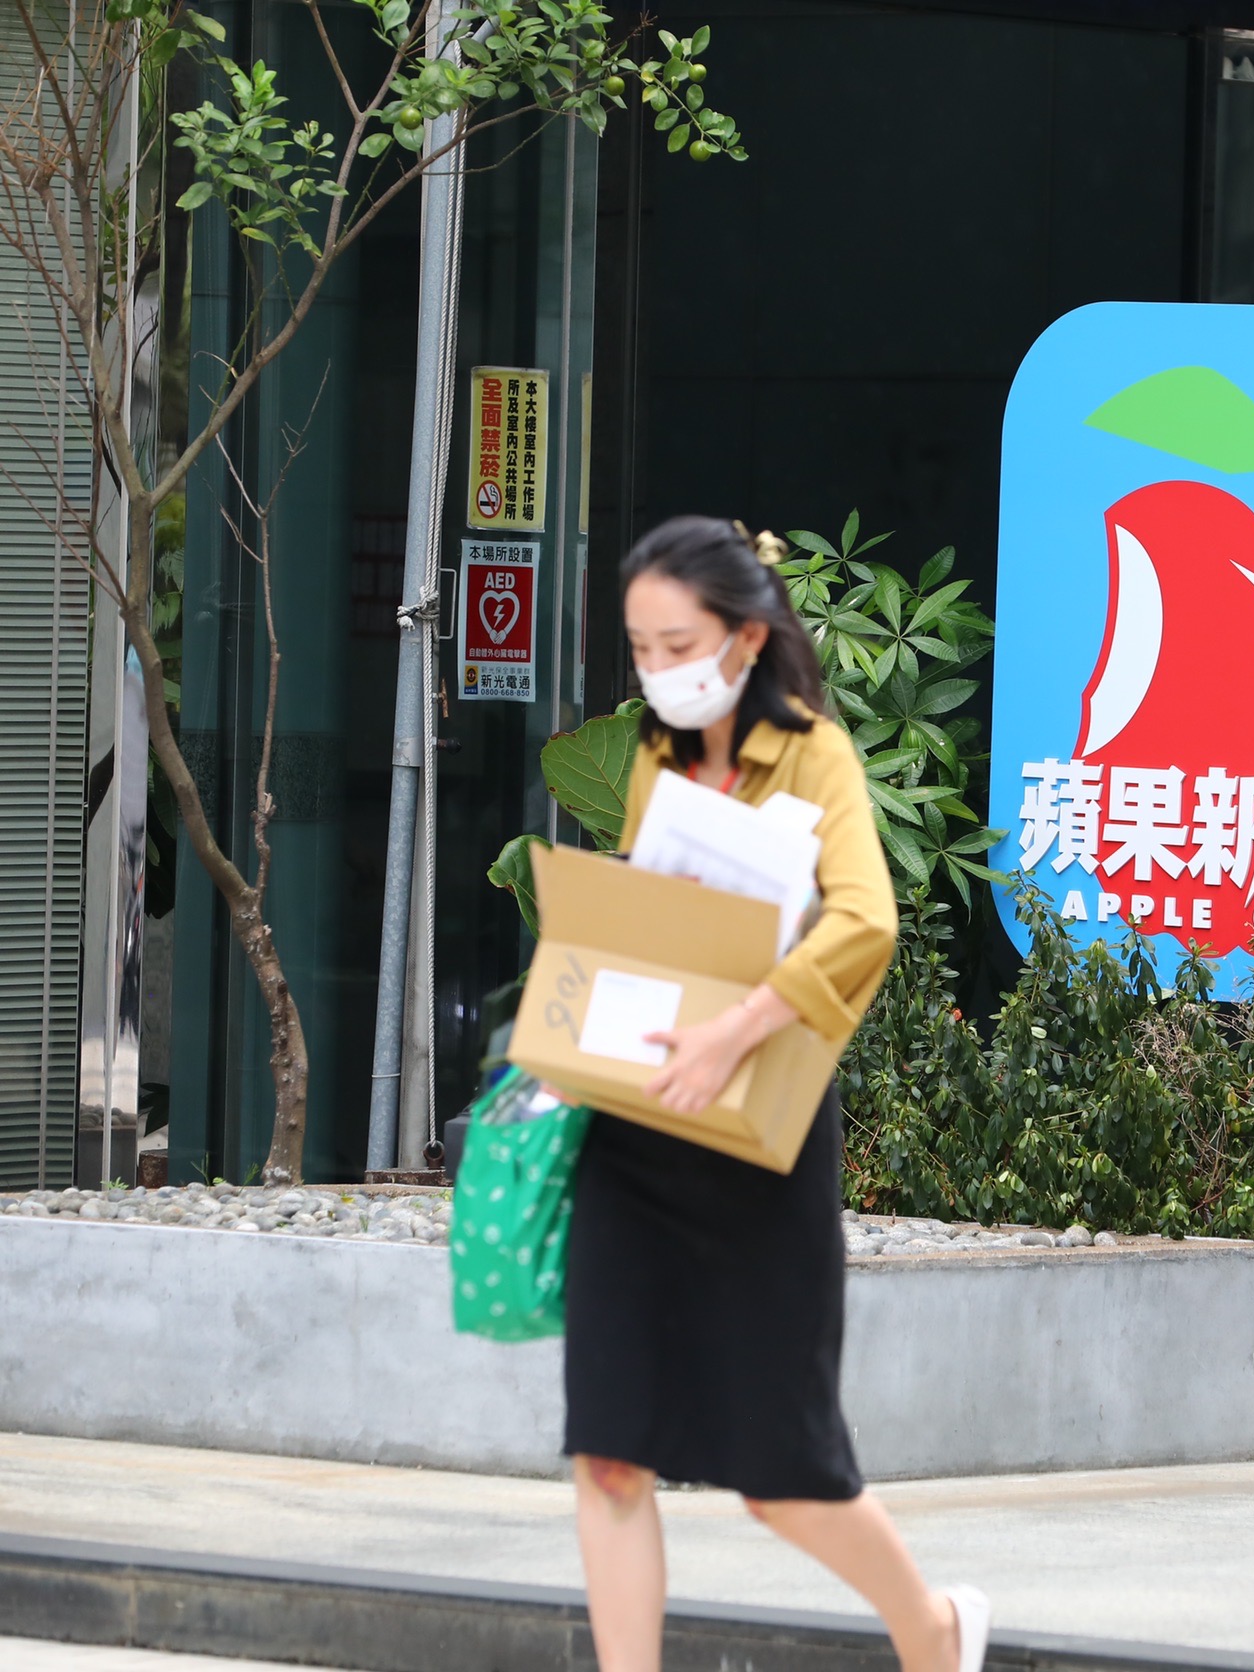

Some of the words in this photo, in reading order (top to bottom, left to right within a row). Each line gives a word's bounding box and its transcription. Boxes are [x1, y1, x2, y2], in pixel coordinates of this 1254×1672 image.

[480, 378, 502, 478] 全面禁菸
[504, 379, 519, 520] 所及室內公共場所
[522, 380, 537, 521] 本大樓室內工作場
[469, 546, 533, 563] 本場所設置
[484, 572, 515, 589] AED
[481, 674, 530, 689] 新光電通
[1060, 890, 1213, 929] APPLE
